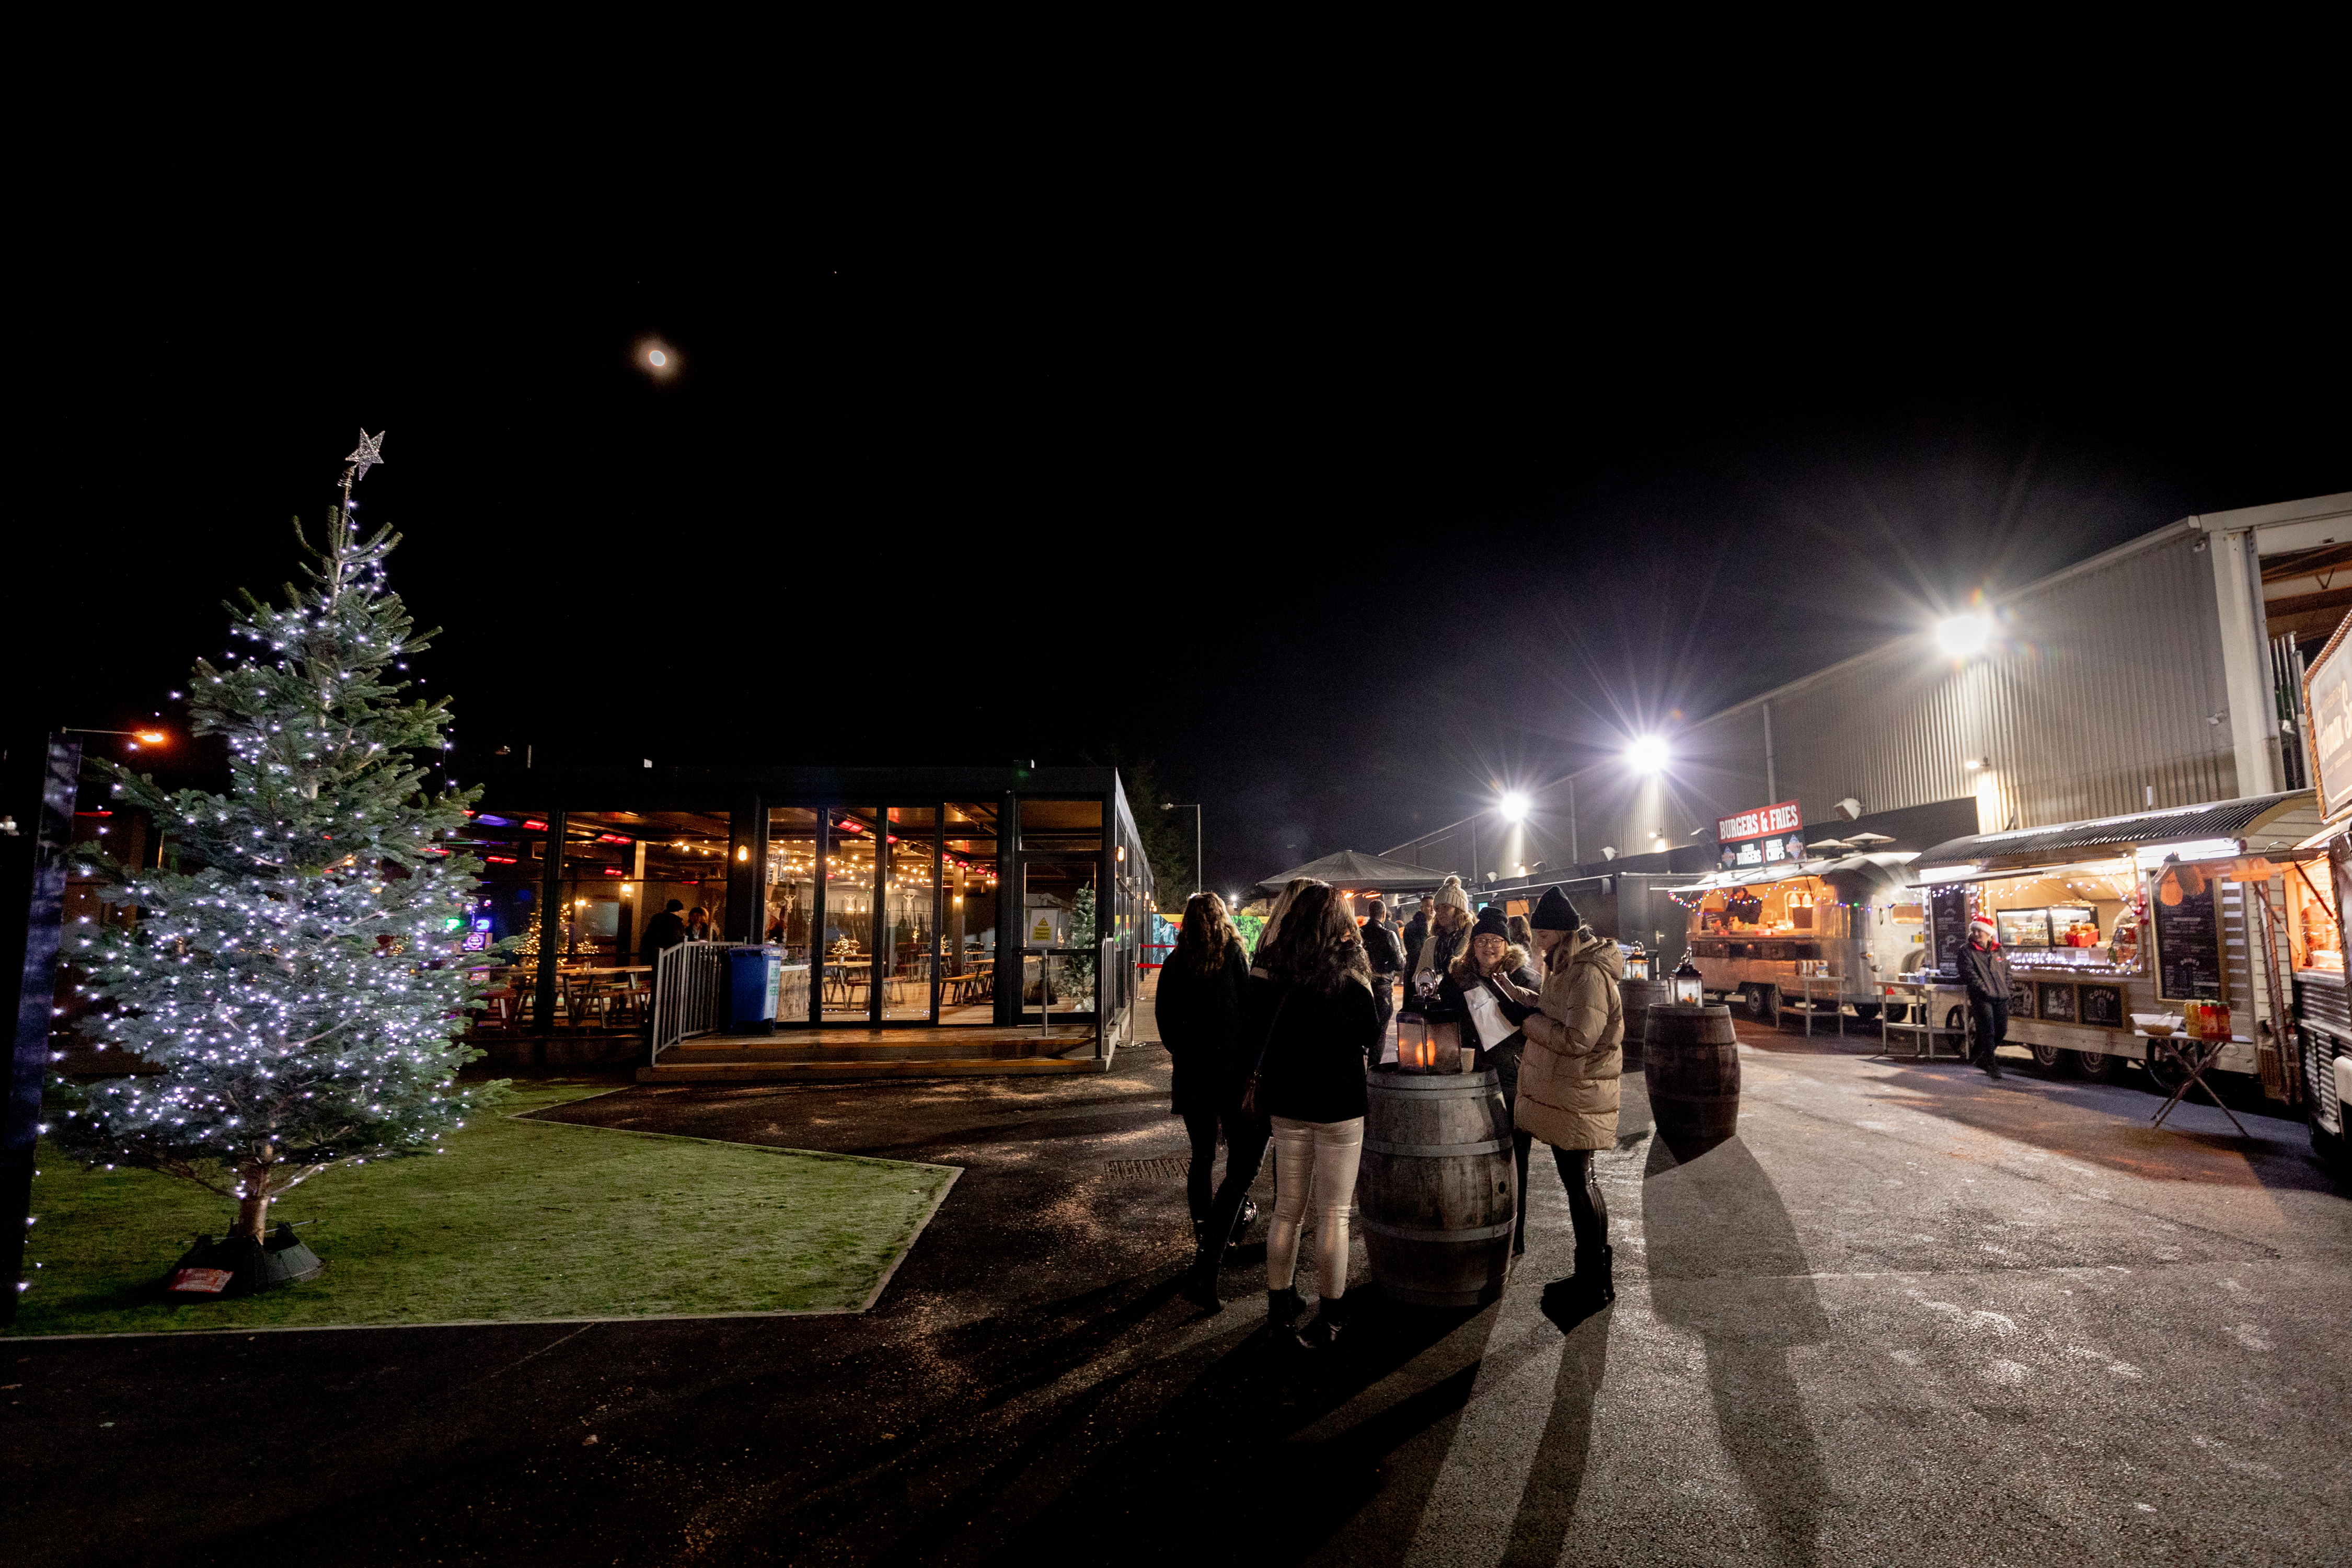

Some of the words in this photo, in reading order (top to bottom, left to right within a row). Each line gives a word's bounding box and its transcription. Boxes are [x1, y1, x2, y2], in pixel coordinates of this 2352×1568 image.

[1719, 813, 1759, 840] BURGERS
[1760, 811, 1769, 833] &
[1769, 804, 1798, 831] FRIES
[1736, 849, 1762, 866] BURGERS
[1766, 846, 1785, 861] CHIPS
